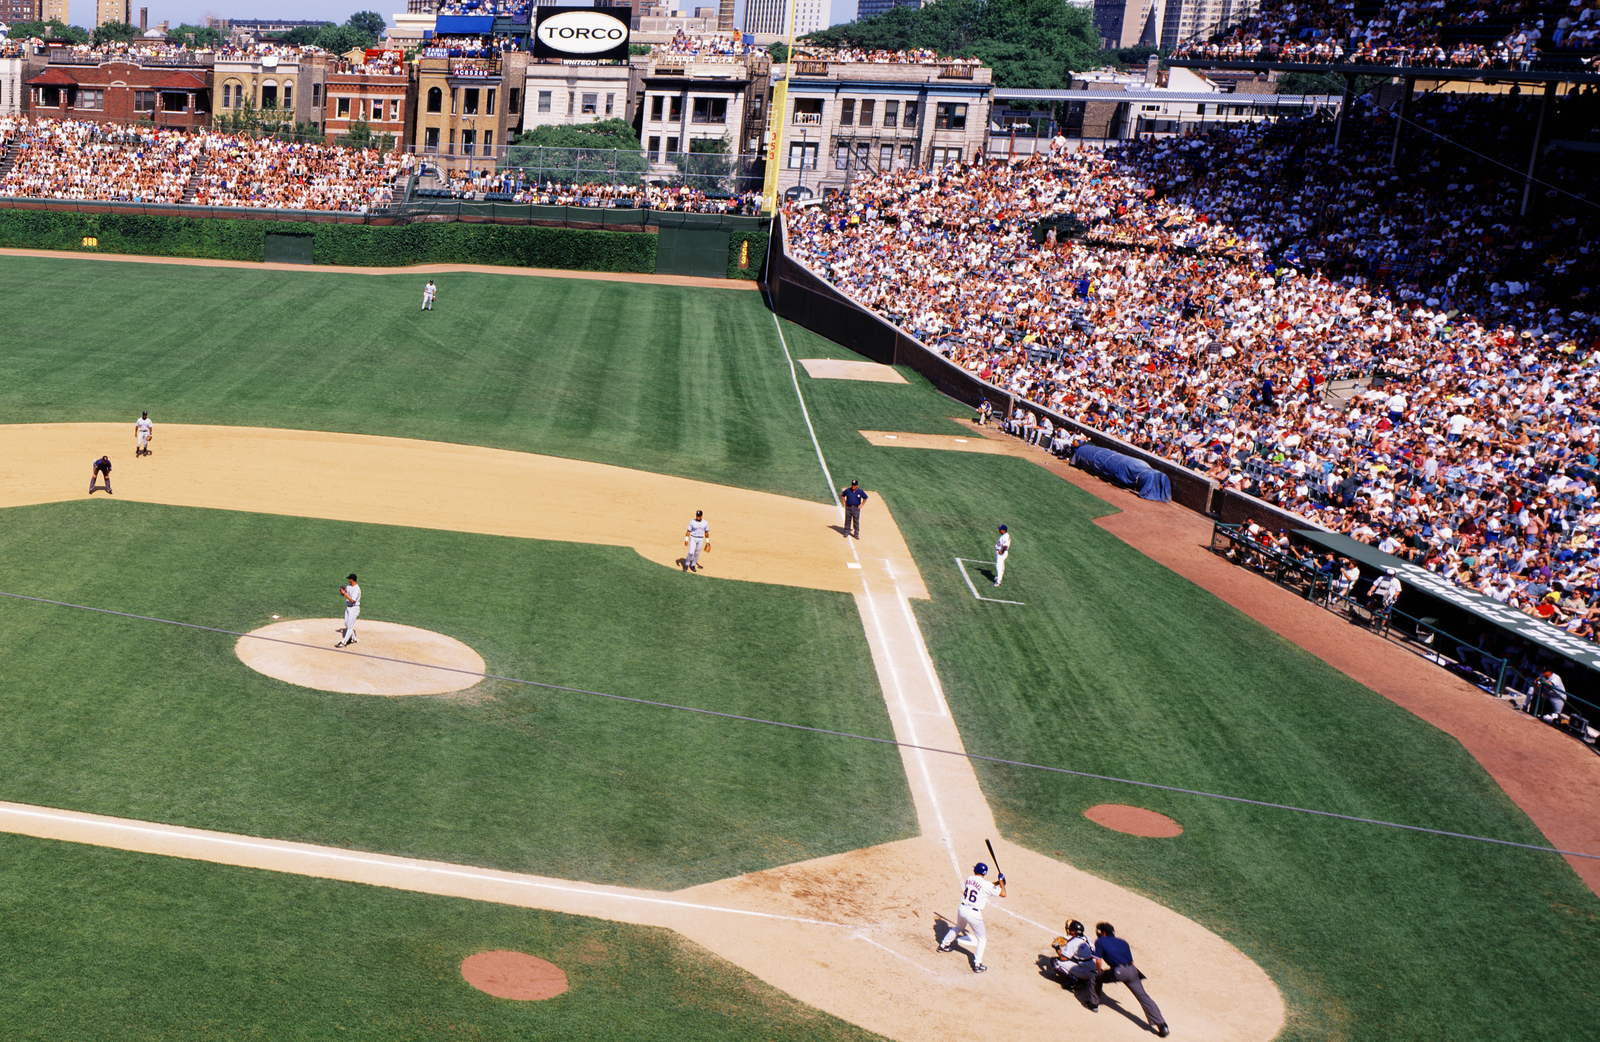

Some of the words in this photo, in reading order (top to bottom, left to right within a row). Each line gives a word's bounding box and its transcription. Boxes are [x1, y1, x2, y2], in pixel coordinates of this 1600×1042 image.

[544, 26, 623, 40] TORCO
[769, 132, 777, 161] 353
[82, 237, 97, 246] 368
[740, 239, 748, 265] 353
[963, 887, 978, 903] 46
